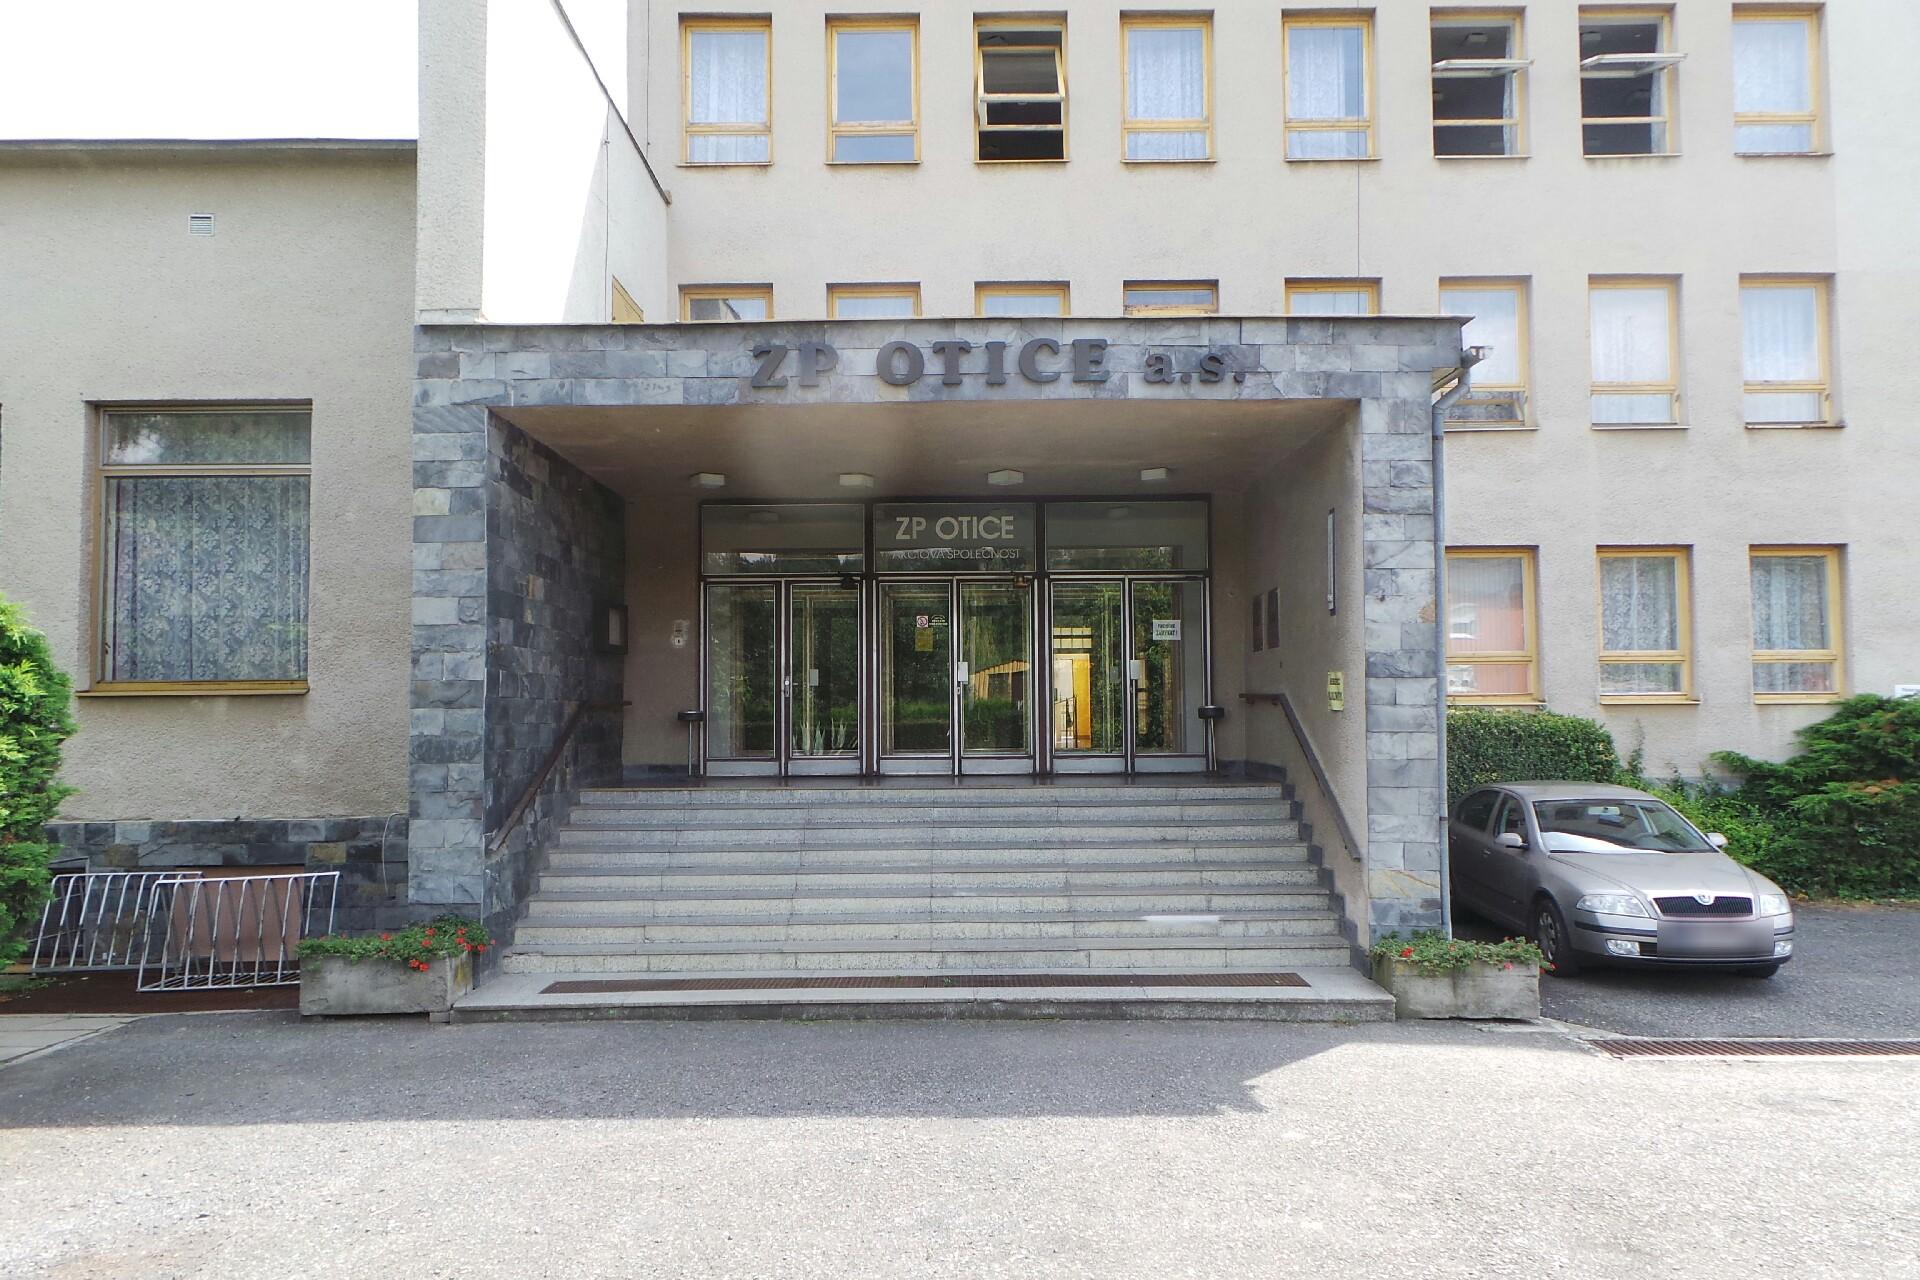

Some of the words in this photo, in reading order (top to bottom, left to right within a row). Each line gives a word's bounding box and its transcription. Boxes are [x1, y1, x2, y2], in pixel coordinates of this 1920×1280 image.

[752, 341, 838, 388] ZP
[876, 338, 1110, 386] OTICE
[1144, 352, 1246, 384] a.s.
[895, 517, 927, 540] ZP
[935, 515, 1015, 540] OTICE
